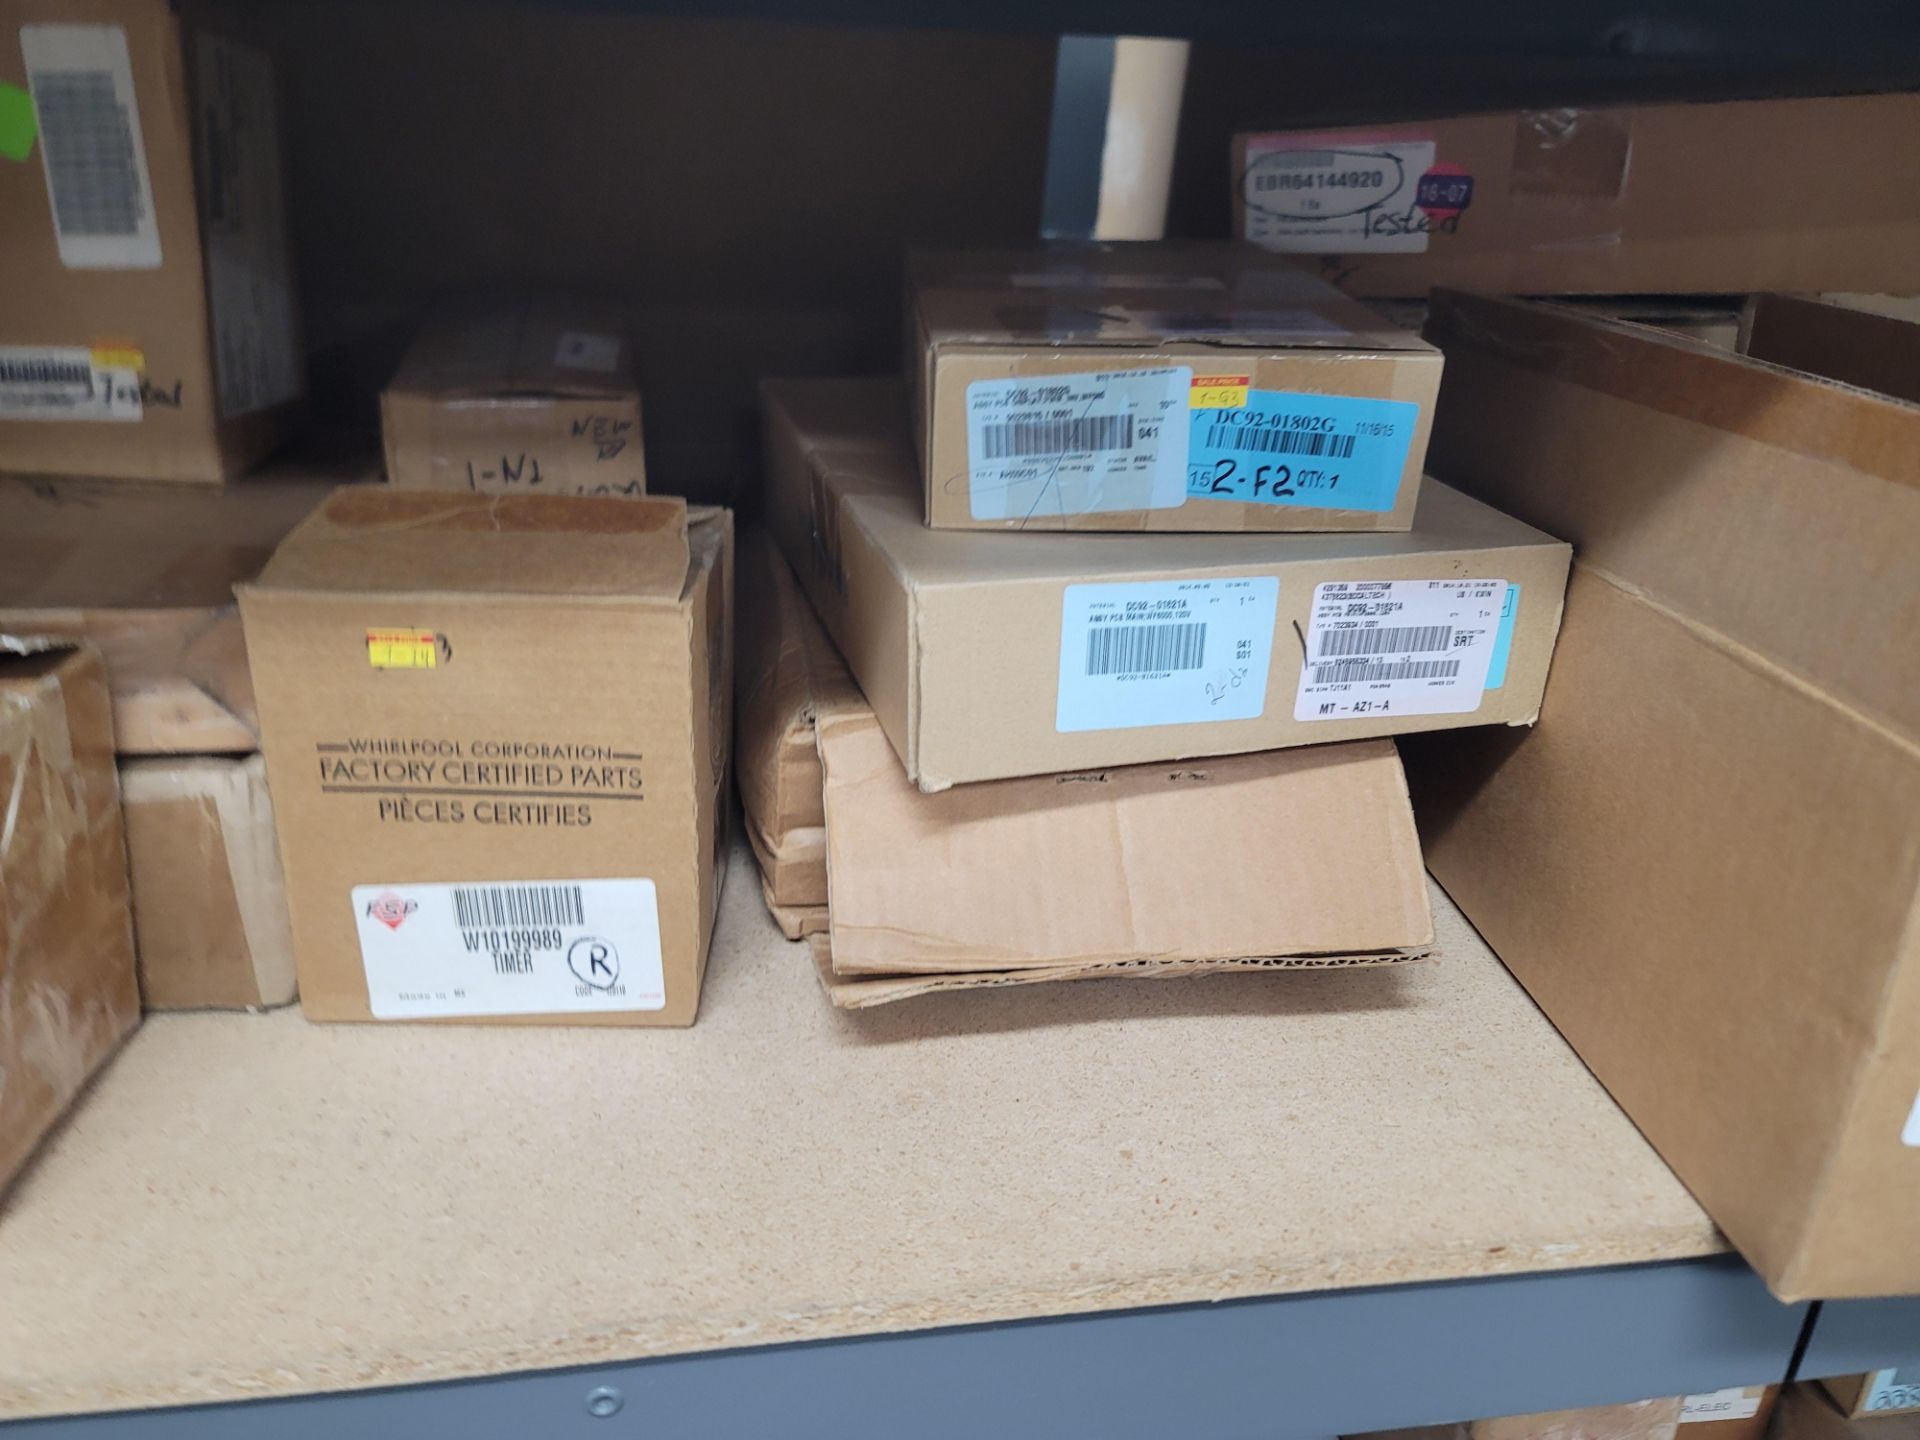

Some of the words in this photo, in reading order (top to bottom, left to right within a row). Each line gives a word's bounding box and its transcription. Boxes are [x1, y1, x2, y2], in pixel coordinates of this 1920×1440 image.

[1357, 203, 1460, 239] Tested
[1216, 409, 1337, 433] DC92-01802G
[1210, 458, 1295, 497] 2-F2
[1329, 474, 1340, 490] 1
[1453, 635, 1475, 648] SRT
[1319, 703, 1336, 715] MT
[1353, 699, 1390, 713] AZ1-A
[349, 738, 463, 757] WHIRLPOOL
[471, 741, 613, 761] CORPORATION
[320, 758, 436, 783] FACTORY
[442, 761, 564, 787] CERTIFIED
[571, 765, 644, 790] PARTS
[379, 795, 465, 823] PIÈCES
[473, 801, 592, 827] CERTIFIES
[462, 929, 563, 953] W10199989
[490, 952, 534, 975] TIMER
[589, 944, 614, 977] R
